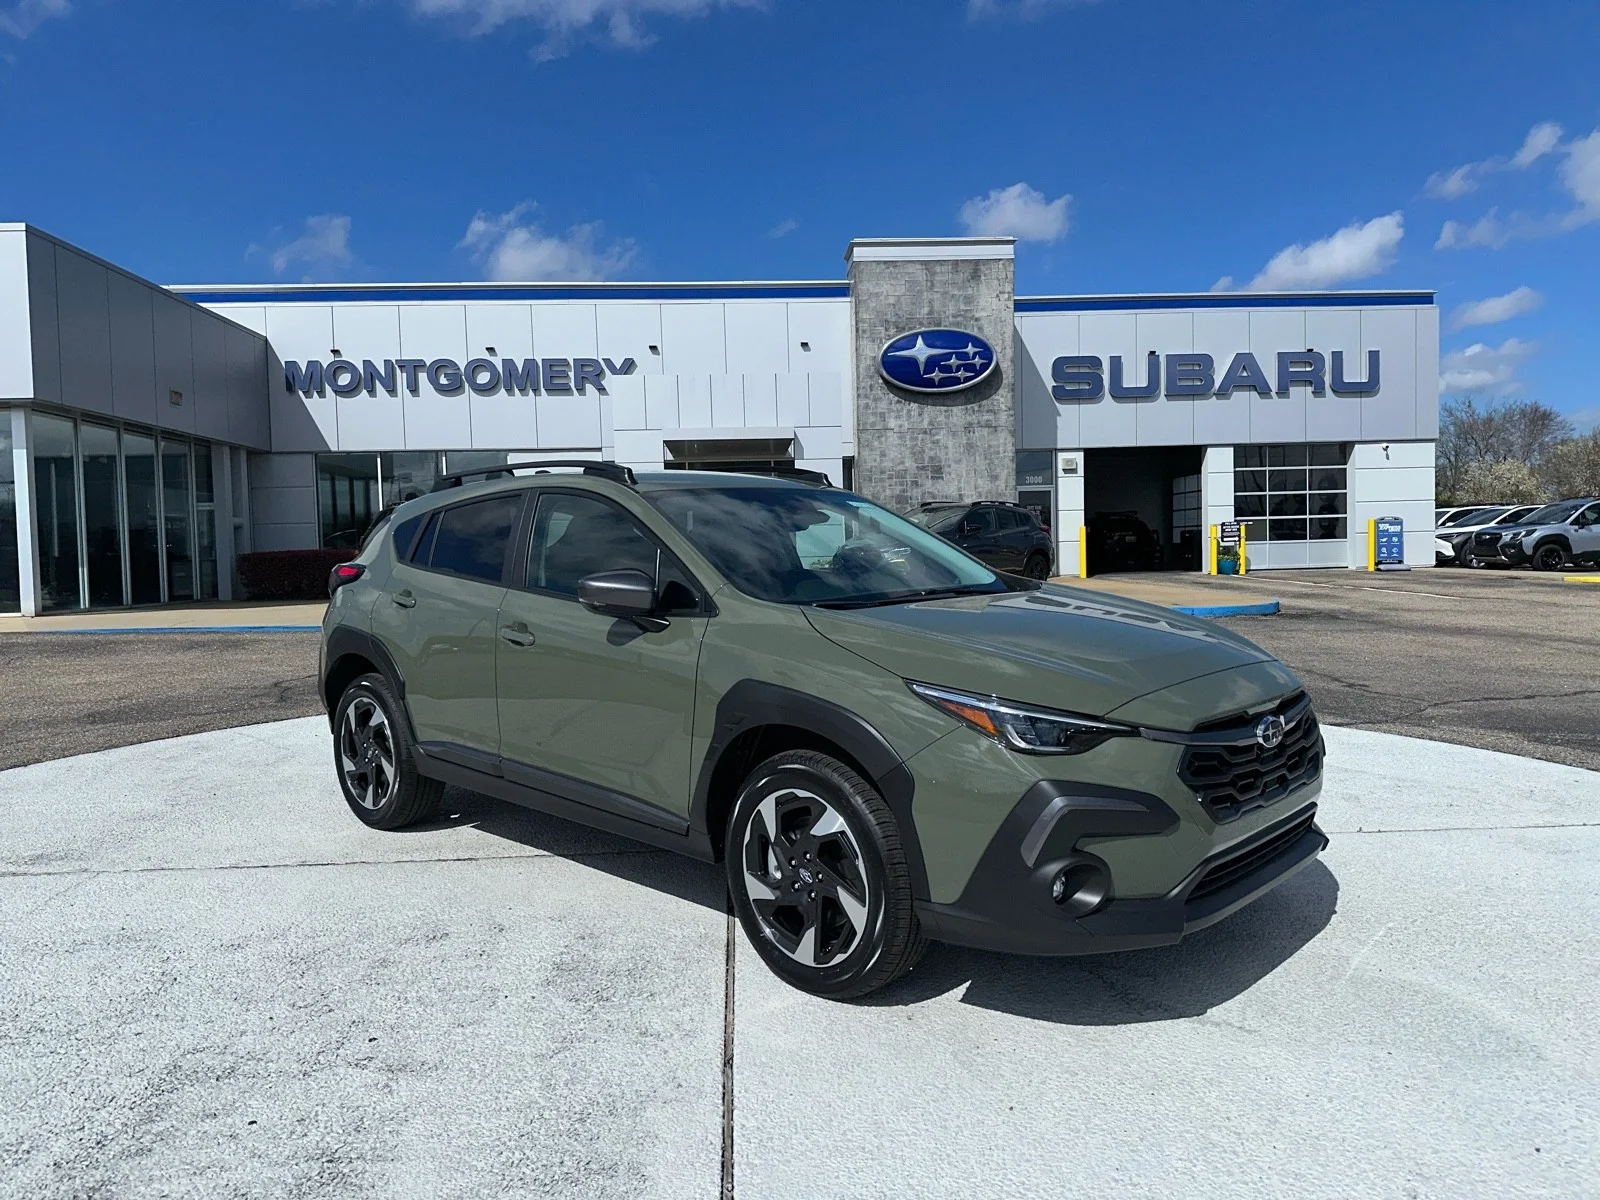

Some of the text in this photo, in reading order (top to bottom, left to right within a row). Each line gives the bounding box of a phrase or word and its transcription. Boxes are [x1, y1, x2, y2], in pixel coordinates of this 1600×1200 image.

[284, 358, 634, 392] MONTGOMERY
[1051, 350, 1381, 399] SUBARU
[1025, 475, 1043, 484] 3000
